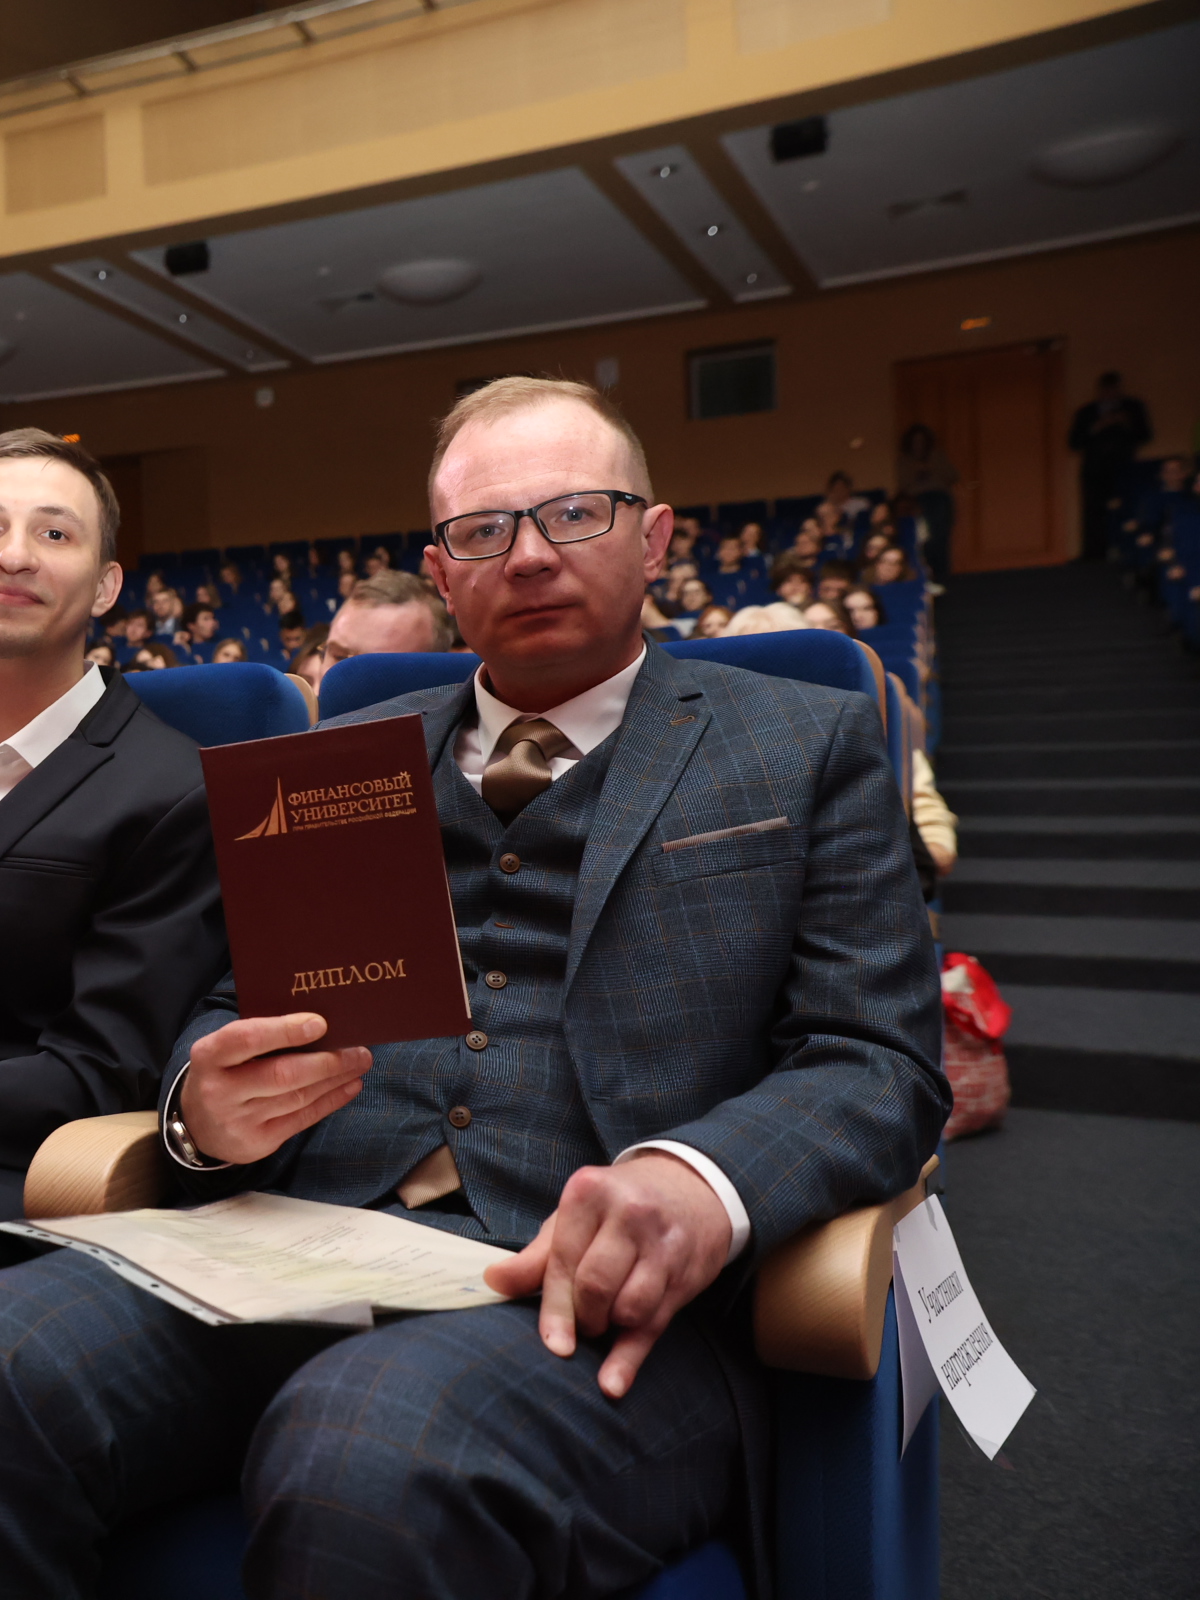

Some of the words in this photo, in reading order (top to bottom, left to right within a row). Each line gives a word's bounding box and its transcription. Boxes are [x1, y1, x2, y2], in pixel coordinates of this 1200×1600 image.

[288, 770, 413, 806] ФИНАНСОВЫЙ
[290, 792, 414, 823] УНИВЕРСИТЕТ
[291, 959, 407, 996] ДИПЛОМ
[918, 1270, 964, 1324] Участники
[940, 1322, 994, 1391] награждения
